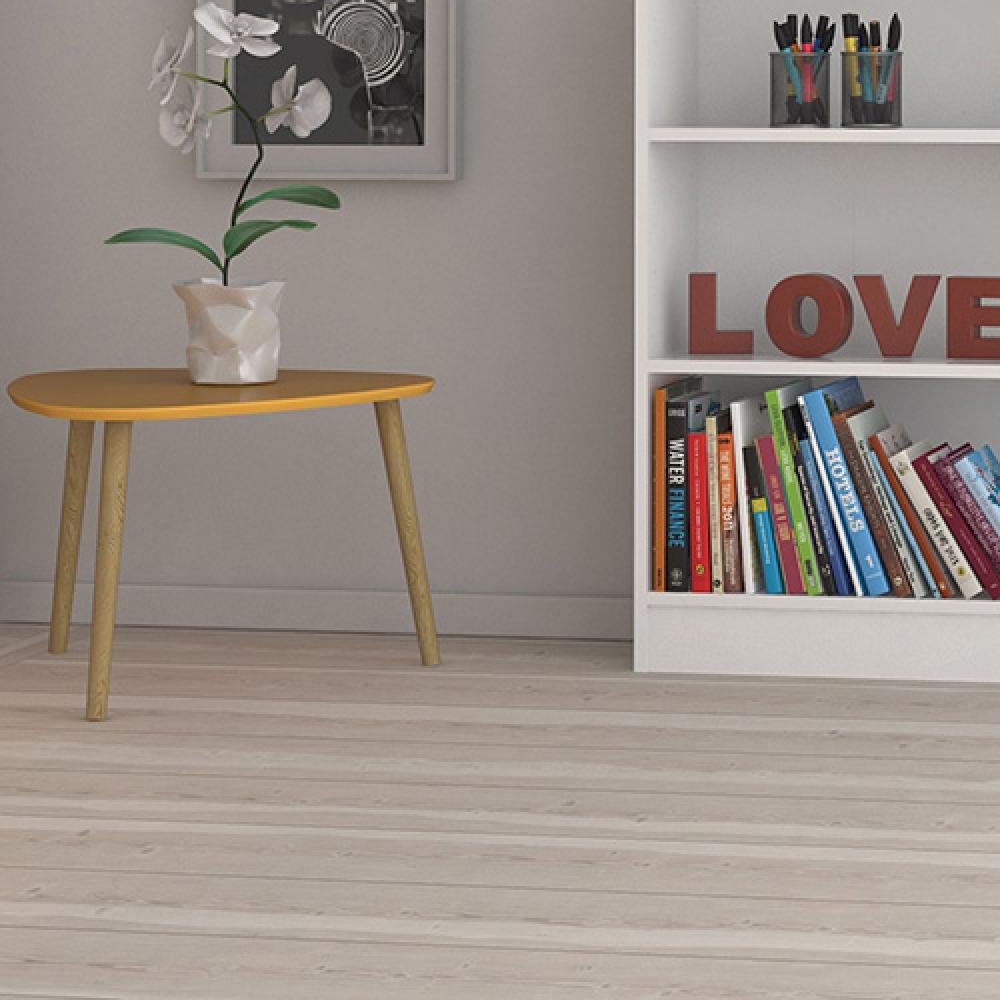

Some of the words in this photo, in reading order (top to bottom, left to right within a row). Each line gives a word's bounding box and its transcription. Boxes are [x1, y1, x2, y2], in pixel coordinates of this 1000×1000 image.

[669, 438, 686, 485] WATER
[824, 445, 866, 534] HOTELS
[669, 487, 686, 548] FINANCE
